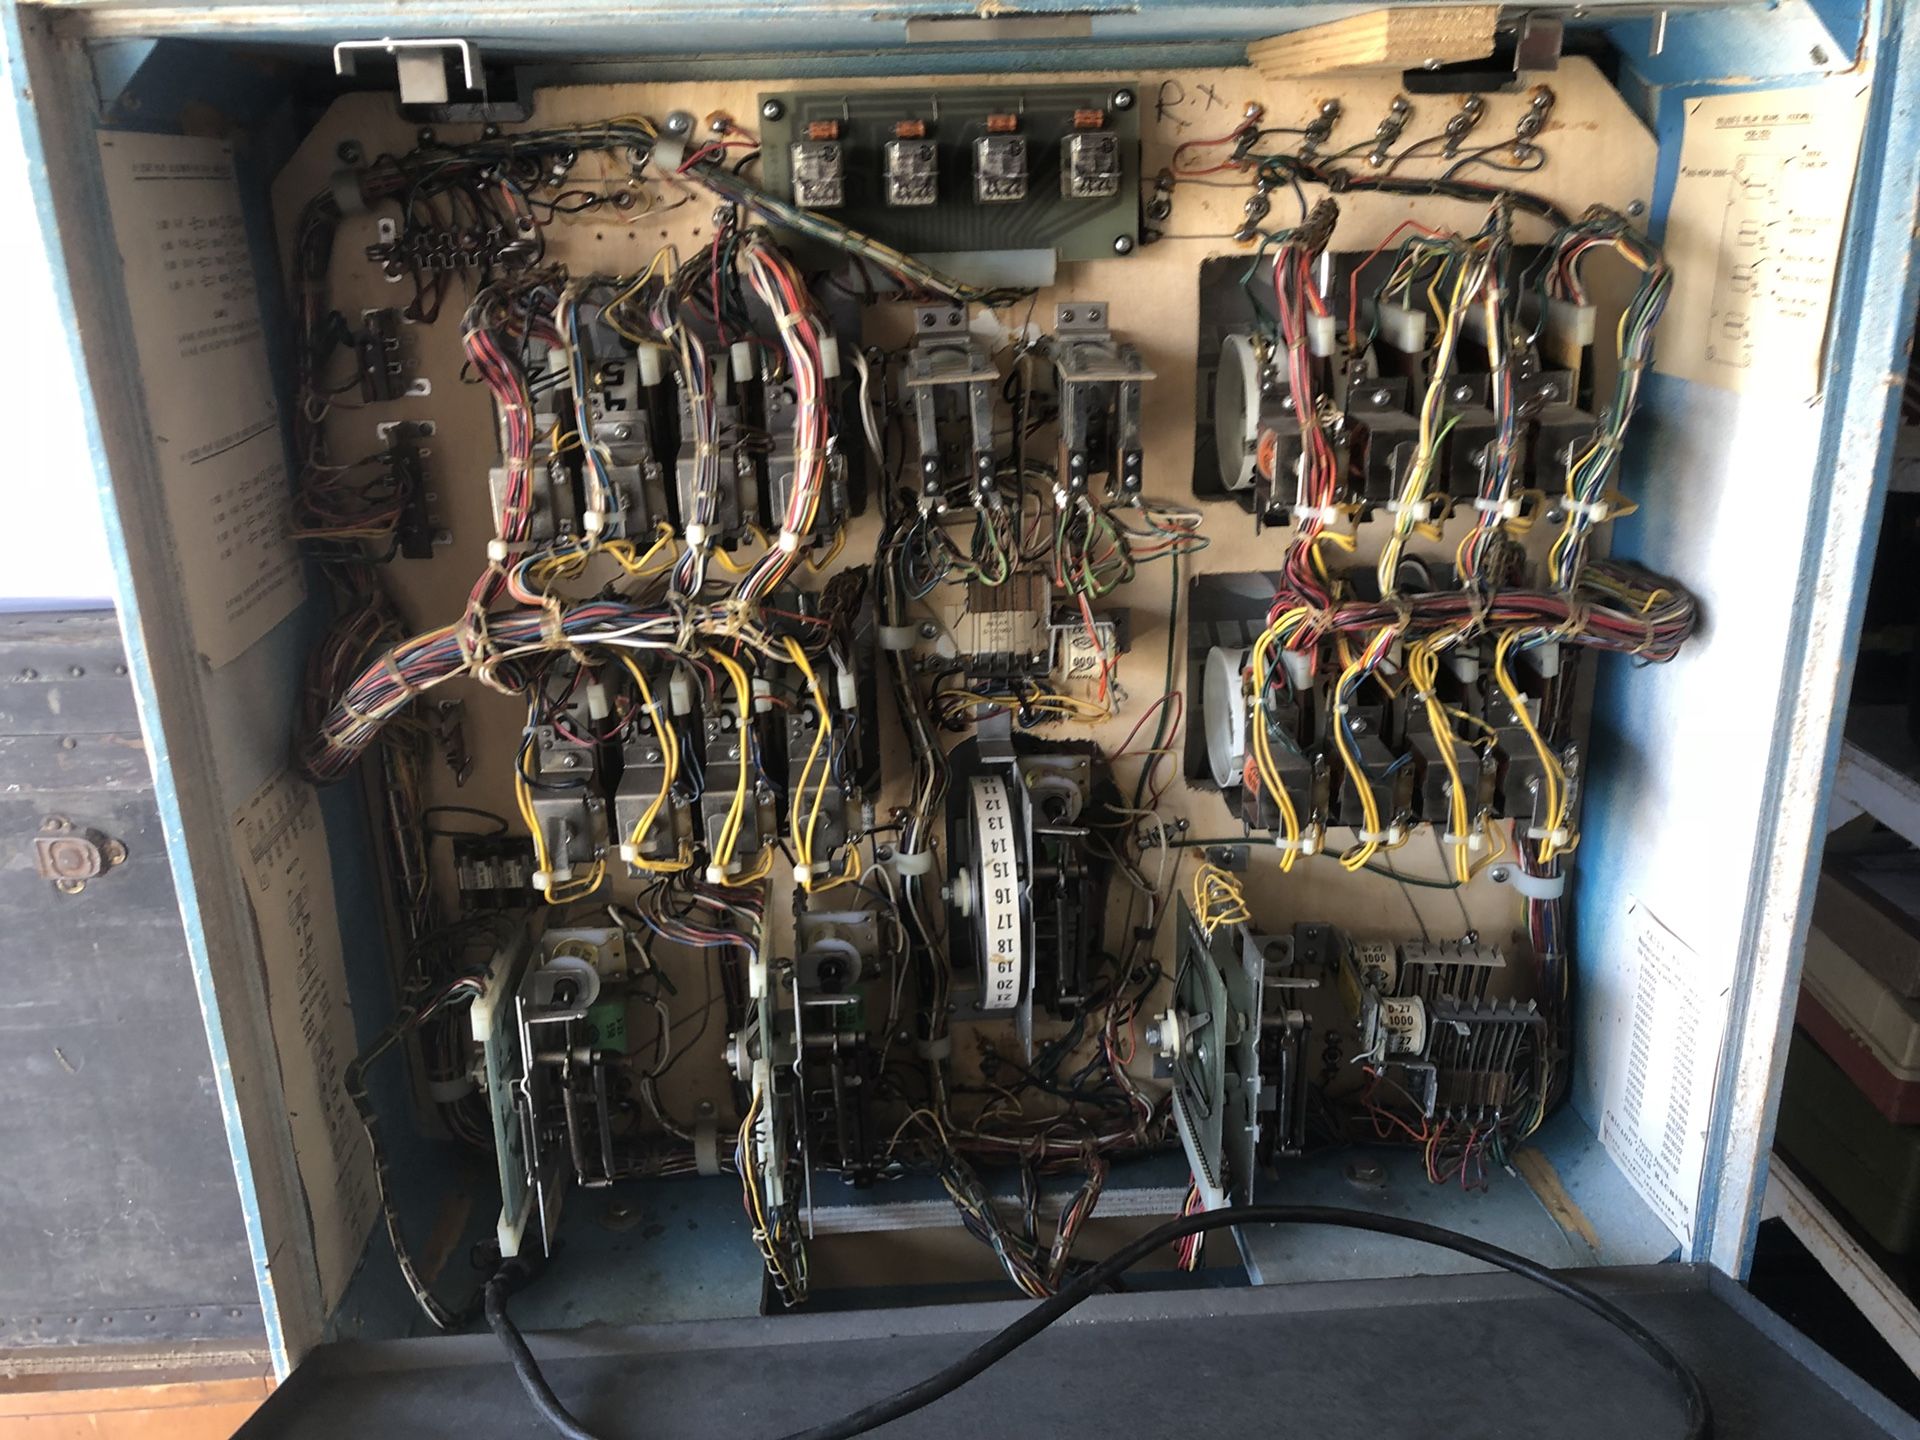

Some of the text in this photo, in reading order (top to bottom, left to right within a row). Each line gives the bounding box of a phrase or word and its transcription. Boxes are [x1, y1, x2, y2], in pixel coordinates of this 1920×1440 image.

[983, 786, 998, 794] 11
[985, 799, 1001, 811] 12
[988, 816, 1004, 830] 13
[991, 838, 1007, 854] 14
[993, 861, 1009, 879] 15
[995, 887, 1011, 904] 16
[997, 913, 1012, 930] 17
[997, 938, 1013, 953] 18
[1364, 953, 1387, 963] 1000
[998, 960, 1014, 974] 19
[997, 980, 1013, 990] 20
[997, 993, 1012, 1001] 21
[1388, 1003, 1411, 1014] D-27
[1389, 1016, 1414, 1026] 1000
